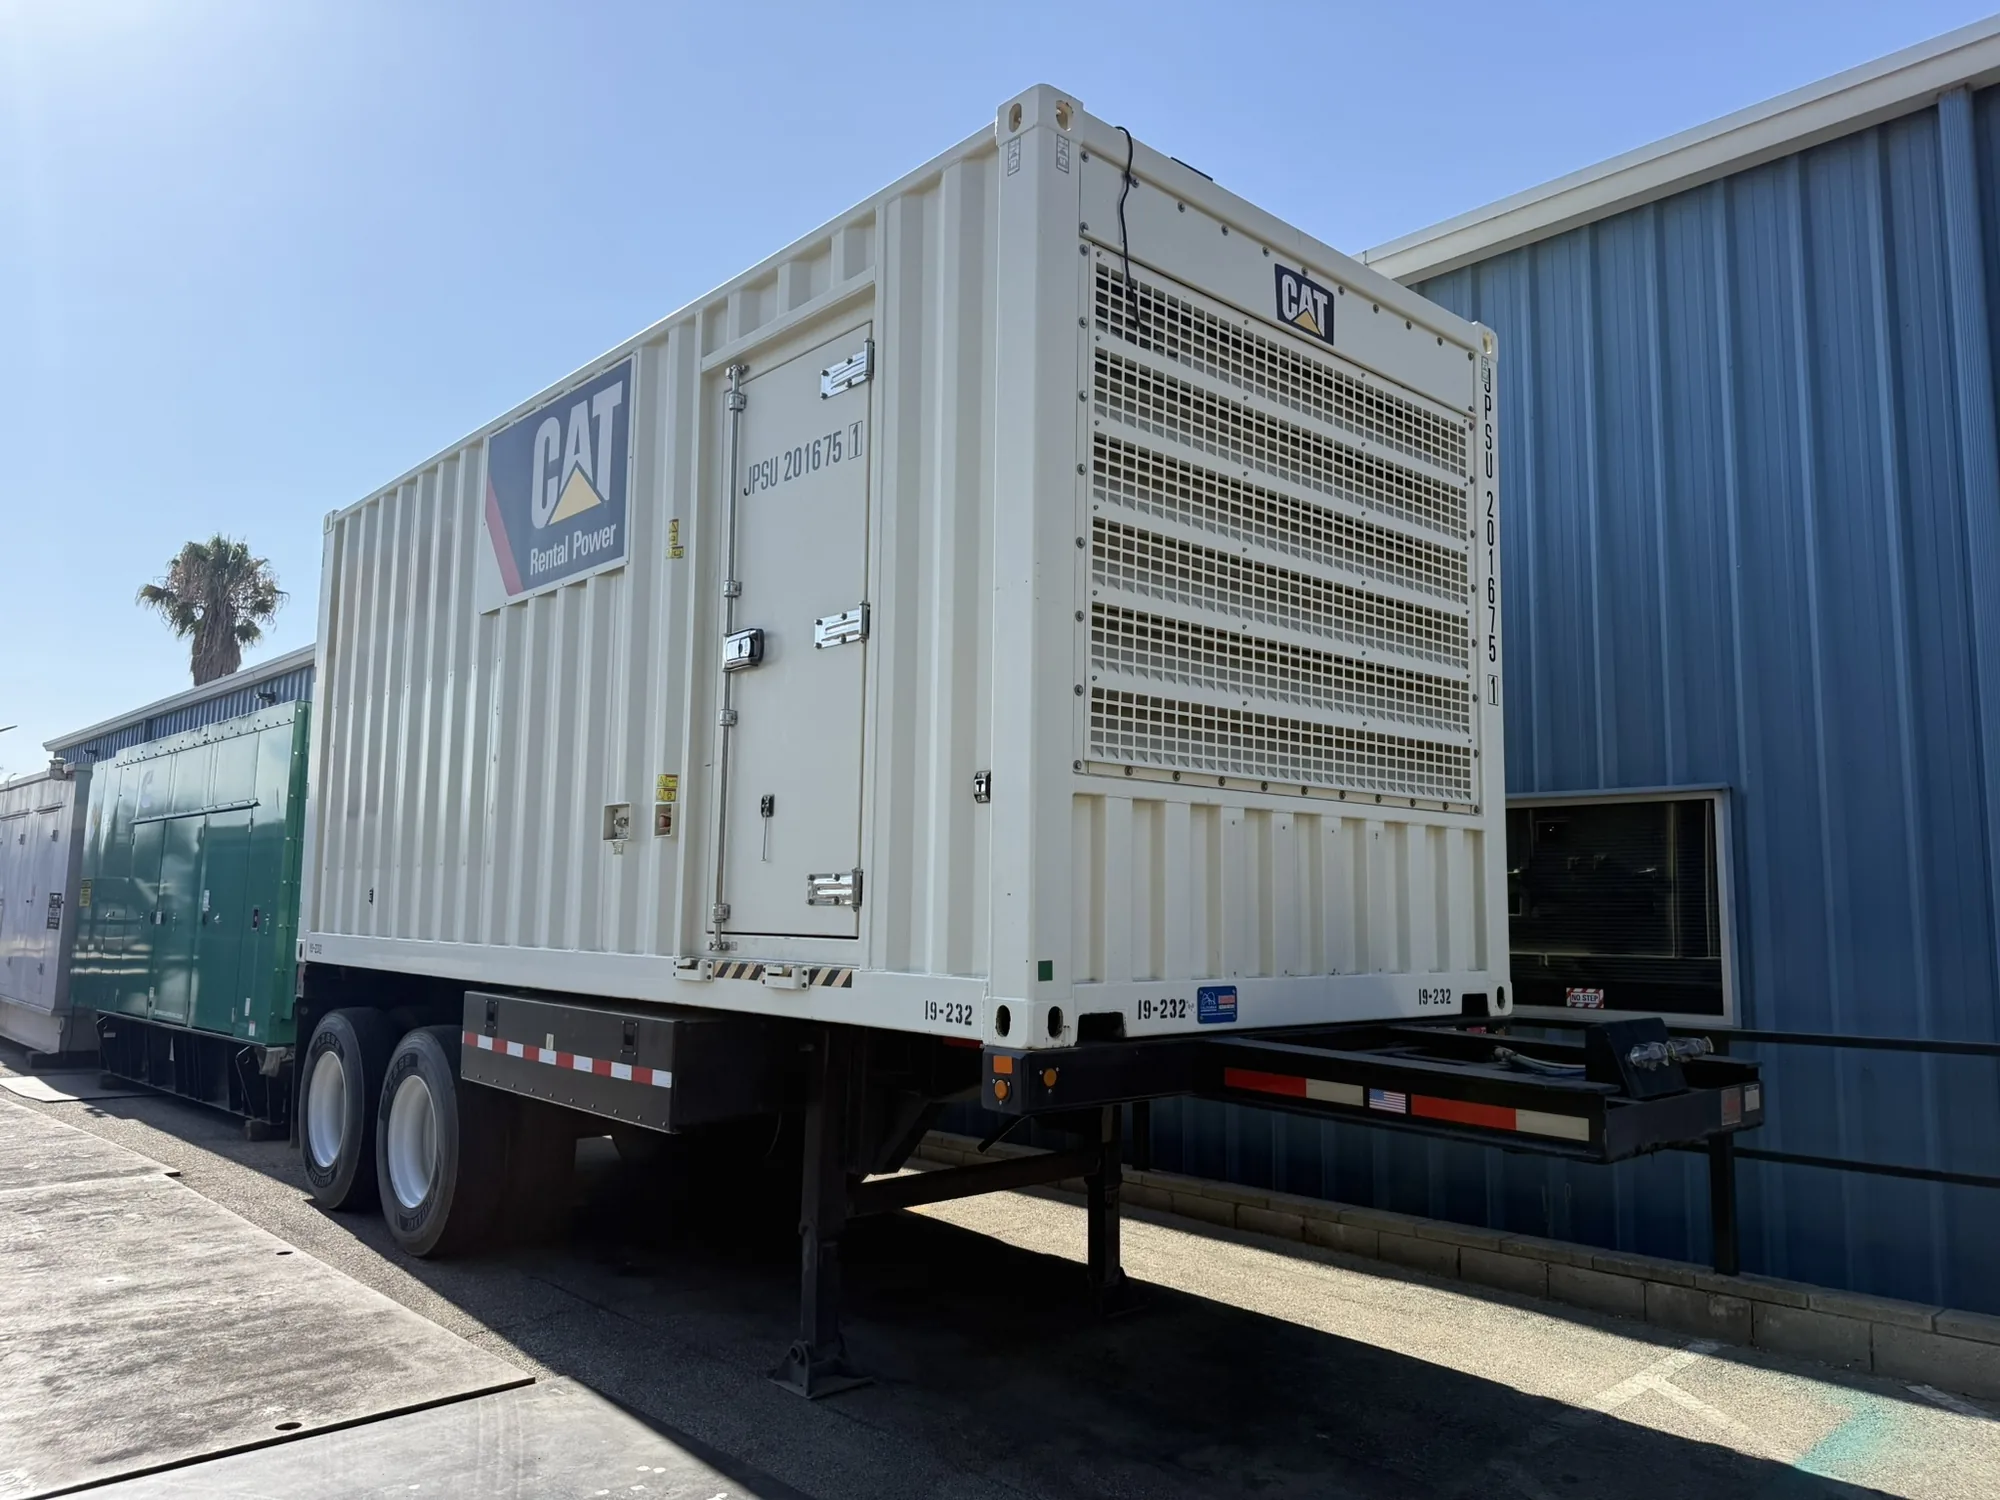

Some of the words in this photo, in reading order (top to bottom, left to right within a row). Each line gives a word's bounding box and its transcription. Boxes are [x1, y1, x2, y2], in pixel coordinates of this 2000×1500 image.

[1281, 274, 1328, 338] CAT
[1484, 367, 1493, 479] JPSU
[531, 380, 623, 529] CAT
[743, 456, 779, 496] JPSU
[784, 430, 842, 481] 201675
[530, 535, 569, 576] Rental
[573, 523, 617, 560] Power
[1486, 491, 1496, 662] 201675
[924, 1000, 973, 1026] 19-232
[1138, 998, 1186, 1020] 19-232
[1418, 988, 1451, 1005] 19-232
[1582, 994, 1599, 1002] STEP
